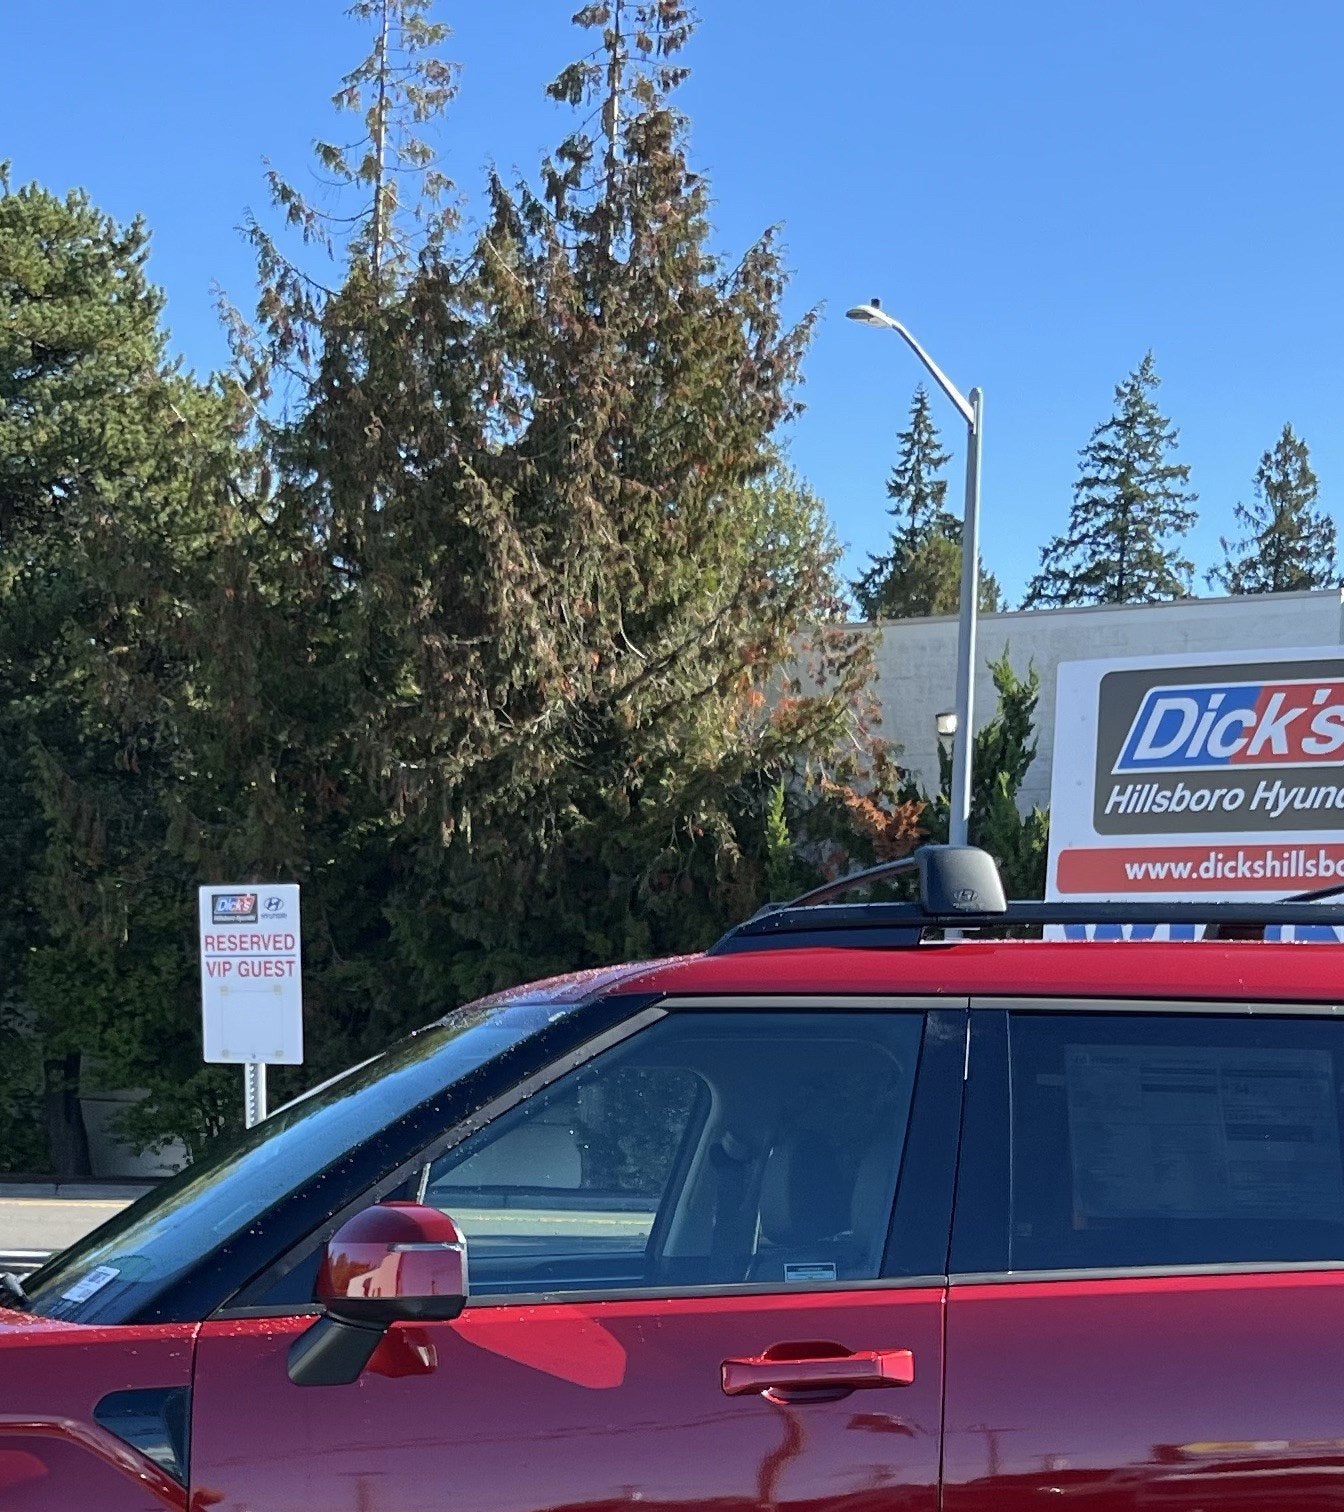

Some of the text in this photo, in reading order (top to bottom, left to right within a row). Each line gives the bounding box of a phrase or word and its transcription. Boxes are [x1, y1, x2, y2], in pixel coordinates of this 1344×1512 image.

[1104, 782, 1245, 815] Hillsboro
[204, 933, 296, 951] RESERVED
[206, 960, 296, 978] VIP GUEST
